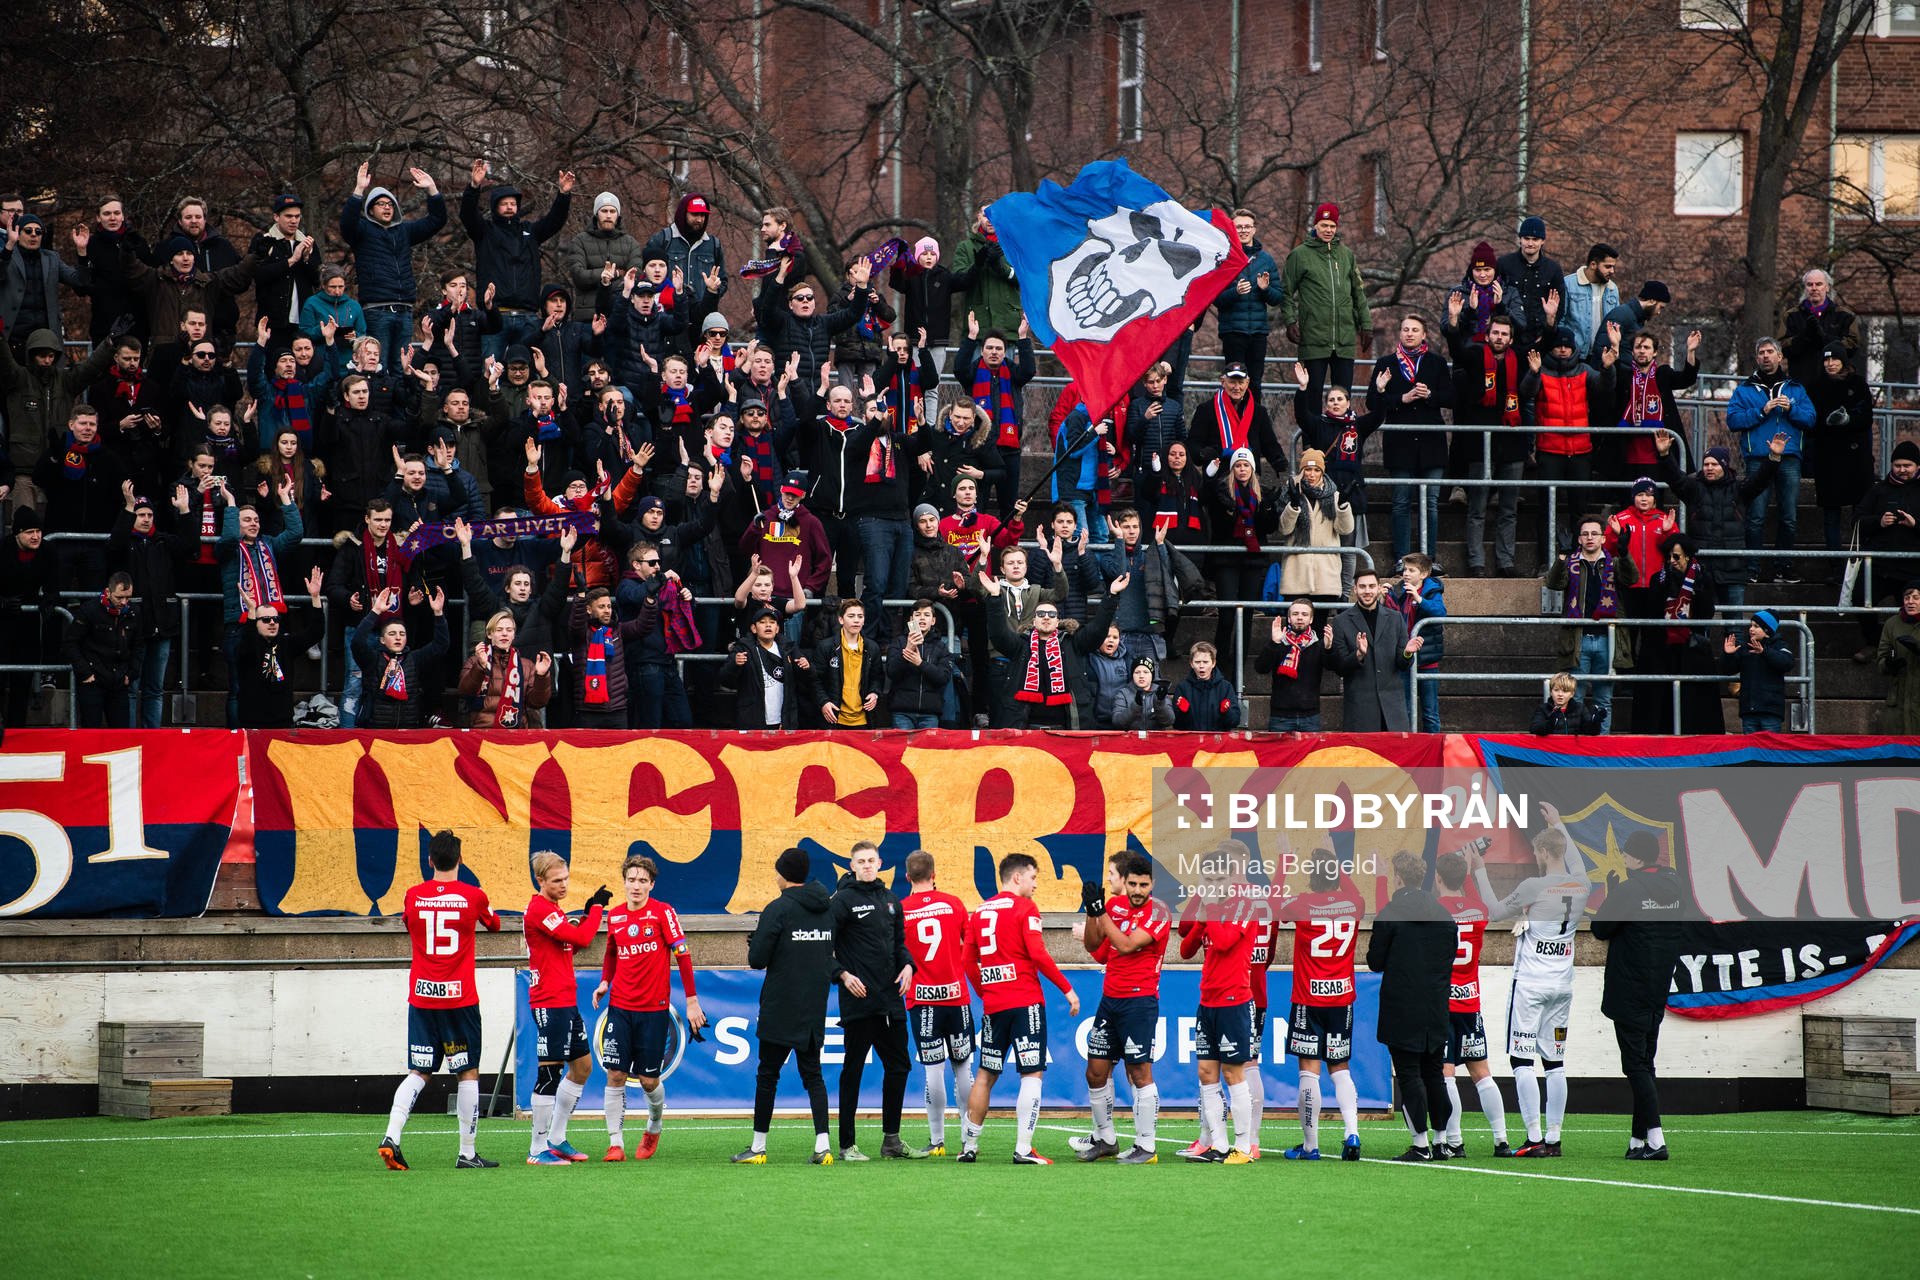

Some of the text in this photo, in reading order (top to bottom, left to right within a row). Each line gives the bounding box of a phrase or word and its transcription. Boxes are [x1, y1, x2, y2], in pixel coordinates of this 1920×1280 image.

[266, 737, 1428, 916] INFERNO
[415, 900, 468, 908] HAMMARVIKEN
[852, 904, 875, 912] stadium
[905, 907, 954, 921] HAMMARVIKEN
[418, 910, 460, 955] 15
[791, 928, 832, 941] stadium
[917, 918, 943, 962] 9
[980, 910, 999, 956] 3
[1310, 915, 1356, 958] 29
[630, 941, 658, 955] BYGG
[1535, 940, 1566, 957] BESAB
[416, 978, 446, 997] BESAB
[916, 984, 948, 1000] BESAB
[1311, 980, 1344, 995] BESAB
[1292, 1031, 1319, 1042] BRIG
[1513, 1031, 1537, 1039] BRIG
[1292, 1044, 1318, 1055] RASTA
